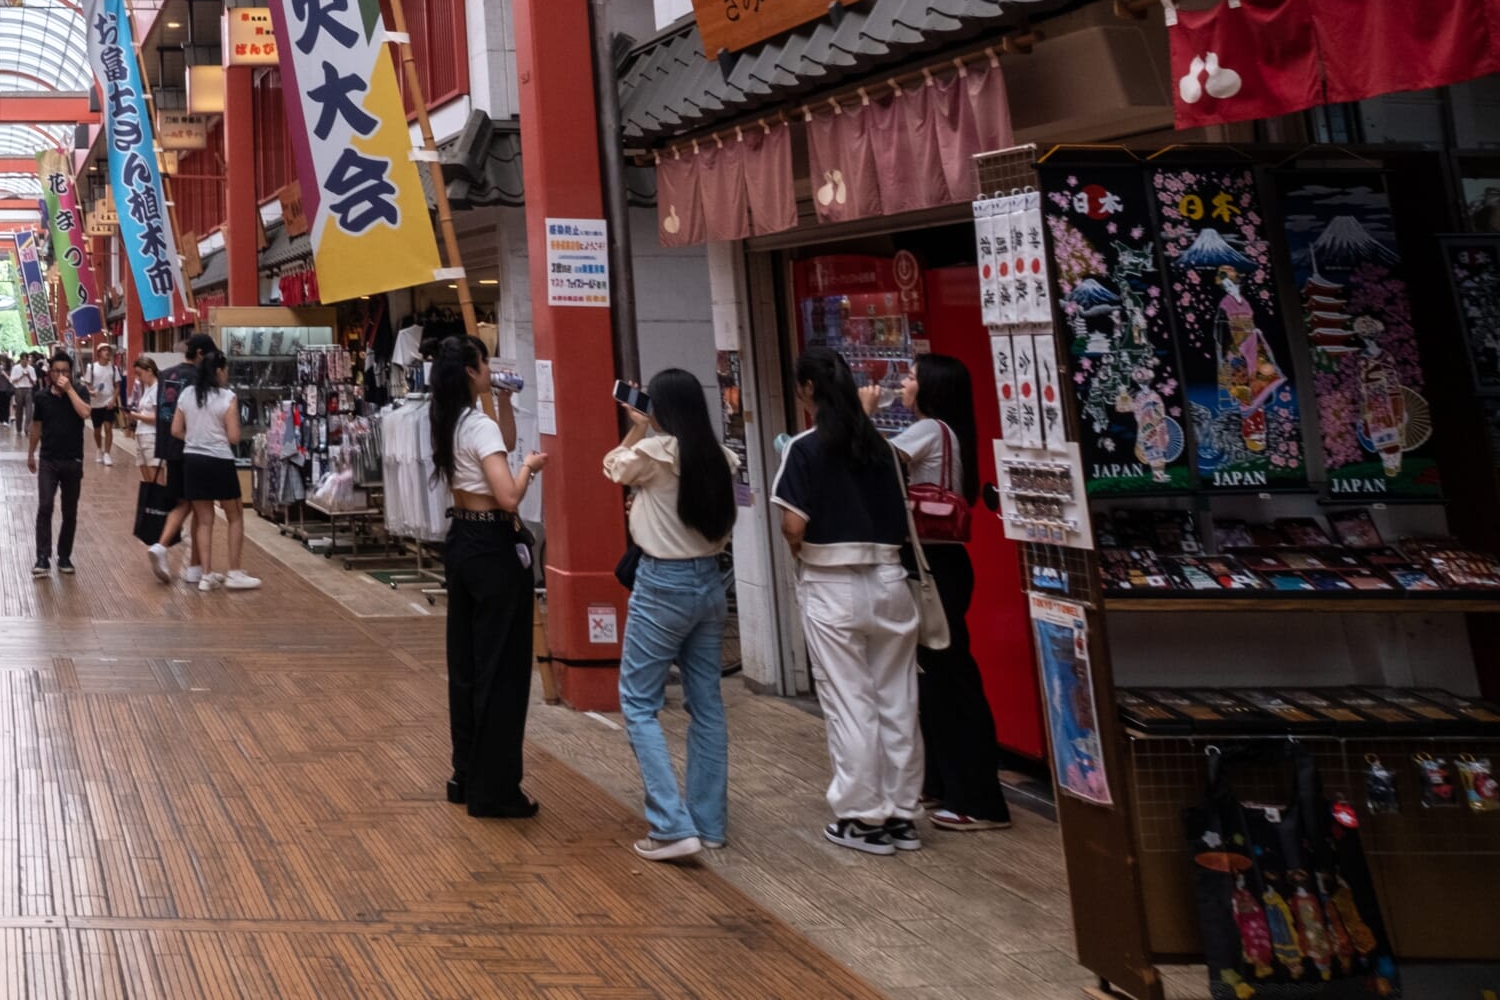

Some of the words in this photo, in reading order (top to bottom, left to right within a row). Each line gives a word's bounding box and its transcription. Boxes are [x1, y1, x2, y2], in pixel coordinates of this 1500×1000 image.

[93, 12, 173, 297] お富士さん植木市
[1071, 189, 1124, 215] 日本
[1178, 190, 1241, 224] 日本
[47, 172, 90, 306] 花まつり
[1092, 463, 1144, 480] JAPAN
[1212, 470, 1268, 486] JAPAN
[1331, 477, 1387, 494] JAPAN
